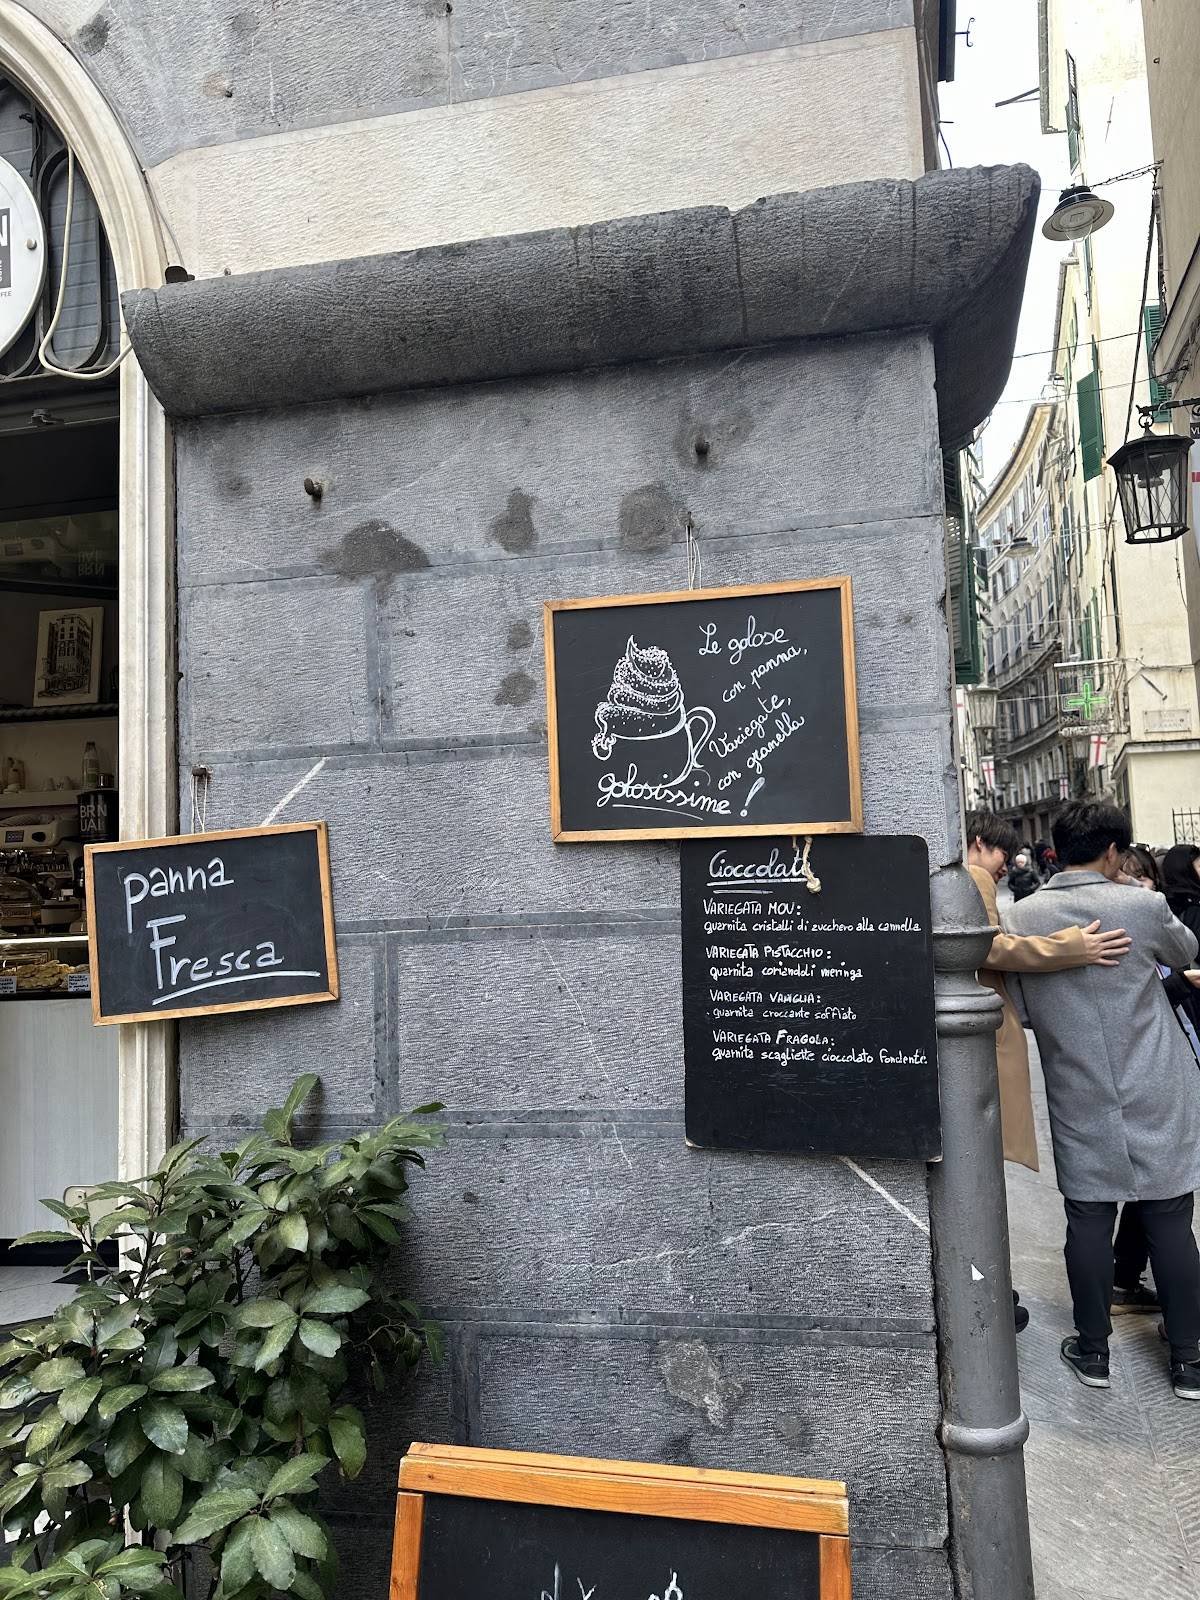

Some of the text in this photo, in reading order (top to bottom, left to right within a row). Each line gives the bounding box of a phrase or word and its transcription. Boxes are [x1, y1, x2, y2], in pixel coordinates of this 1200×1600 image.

[698, 615, 789, 665] Le golose
[722, 681, 746, 703] con
[717, 712, 805, 791] con granella
[702, 898, 762, 915] VARIEGATA
[703, 917, 922, 935] guarnita cristalli di zucchero alla cannella
[145, 913, 285, 990] Fresca
[705, 943, 759, 959] VARIEGATA
[709, 960, 864, 982] guarnita coriandoli meringa
[709, 989, 763, 1003] VARIEGATA
[712, 1004, 857, 1020] guarnita croccante soffiato
[712, 1028, 772, 1044] VARIEGATA
[711, 1044, 754, 1061] guarnita
[760, 1047, 816, 1067] scagliette
[821, 1047, 874, 1064] cioccolato
